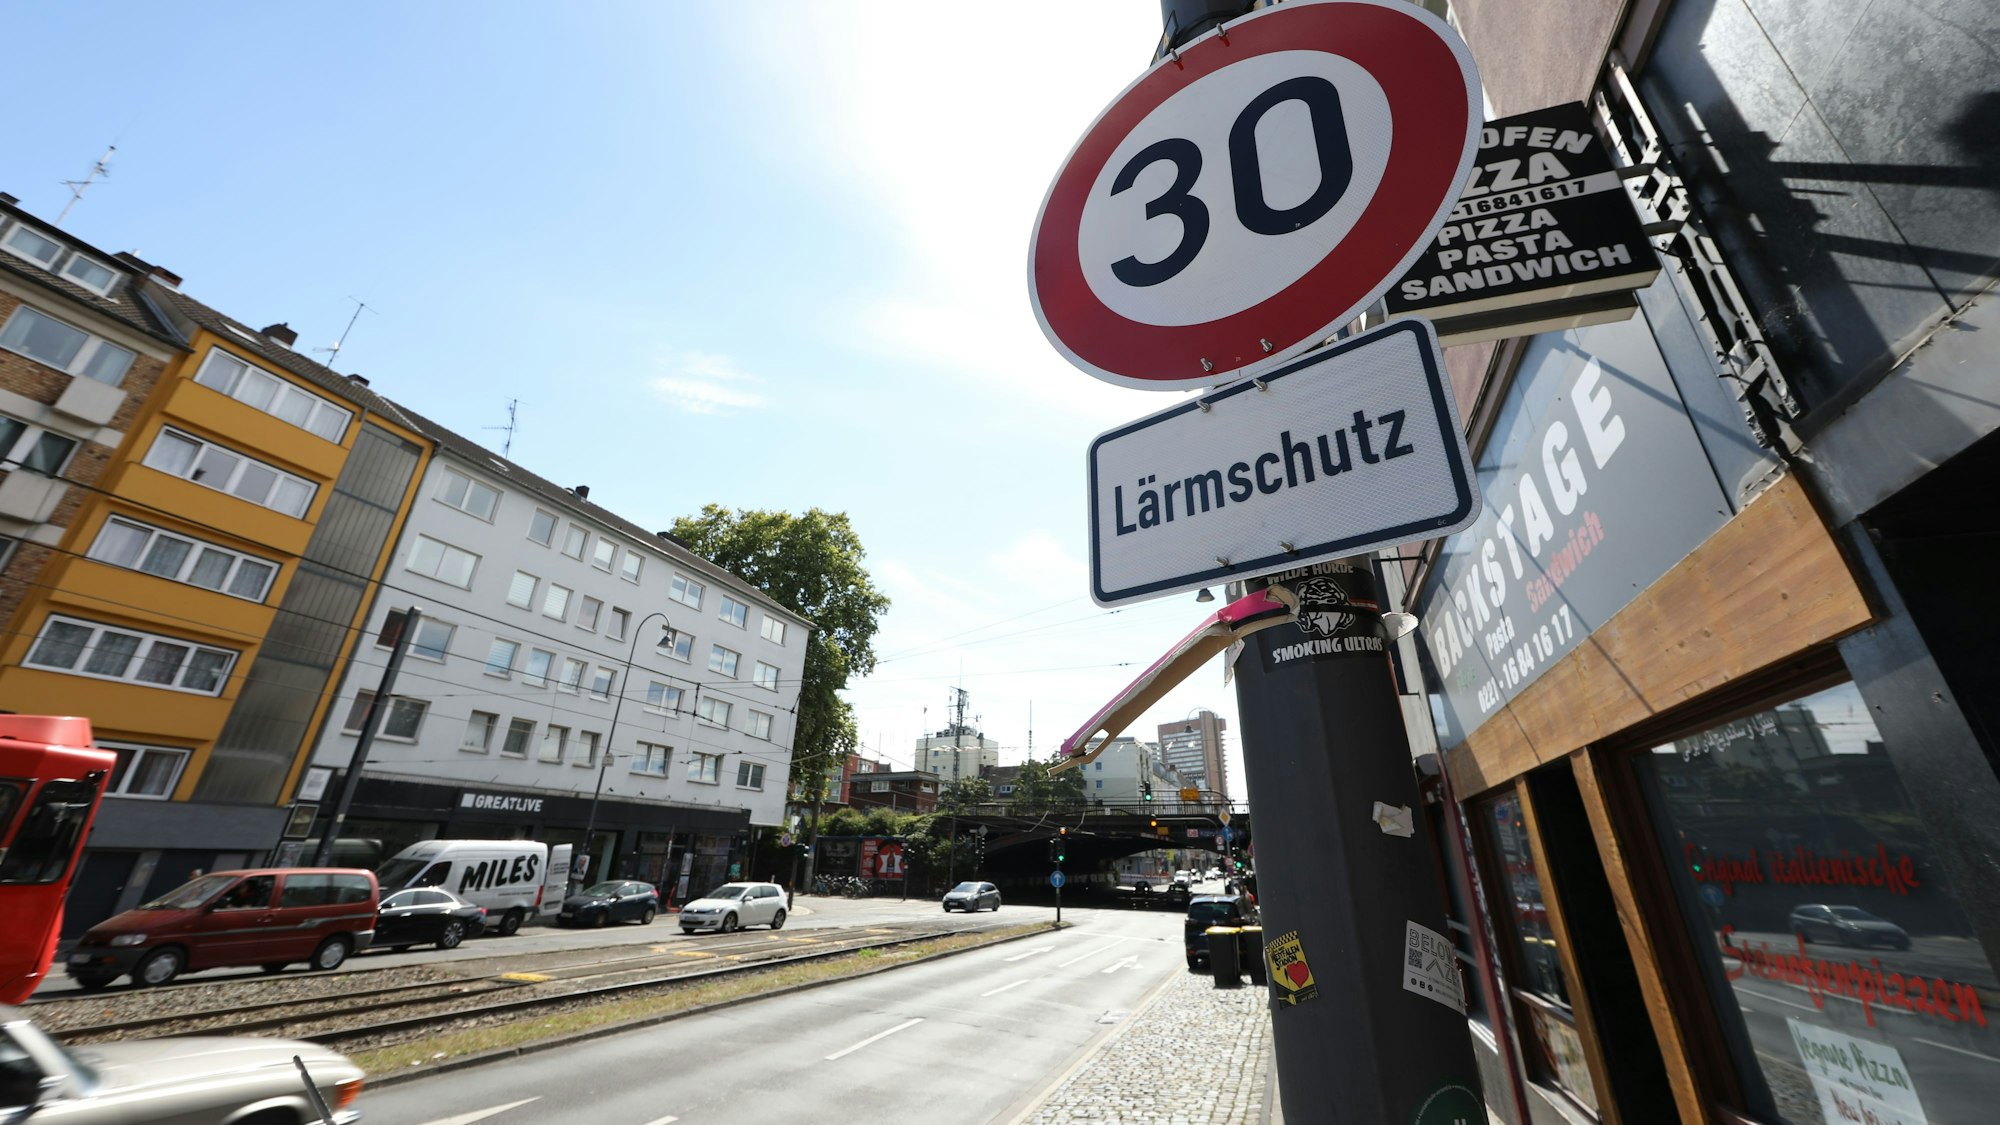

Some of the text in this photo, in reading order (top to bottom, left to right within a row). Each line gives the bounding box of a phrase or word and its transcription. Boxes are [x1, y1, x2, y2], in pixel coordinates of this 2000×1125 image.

[1110, 75, 1353, 287] 30
[1437, 208, 1558, 246] PIZZA
[1437, 230, 1573, 270] PASTA
[1401, 243, 1632, 300] SANDWICH
[1115, 410, 1414, 536] Lärmschutz
[1434, 355, 1625, 679] BACKSTAGE
[1526, 510, 1605, 613] Sandwich
[1272, 636, 1383, 664] SMOKING ULTRAS
[1478, 676, 1499, 713] 0221
[1502, 657, 1520, 690] 16
[1516, 642, 1535, 677] 84
[1532, 625, 1554, 662] 16
[1551, 603, 1573, 646] 17
[1485, 615, 1515, 660] Pasta
[458, 854, 538, 895] MILES
[1685, 842, 1920, 896] Original italienische
[1720, 924, 1988, 1028] Steinofenpizzen
